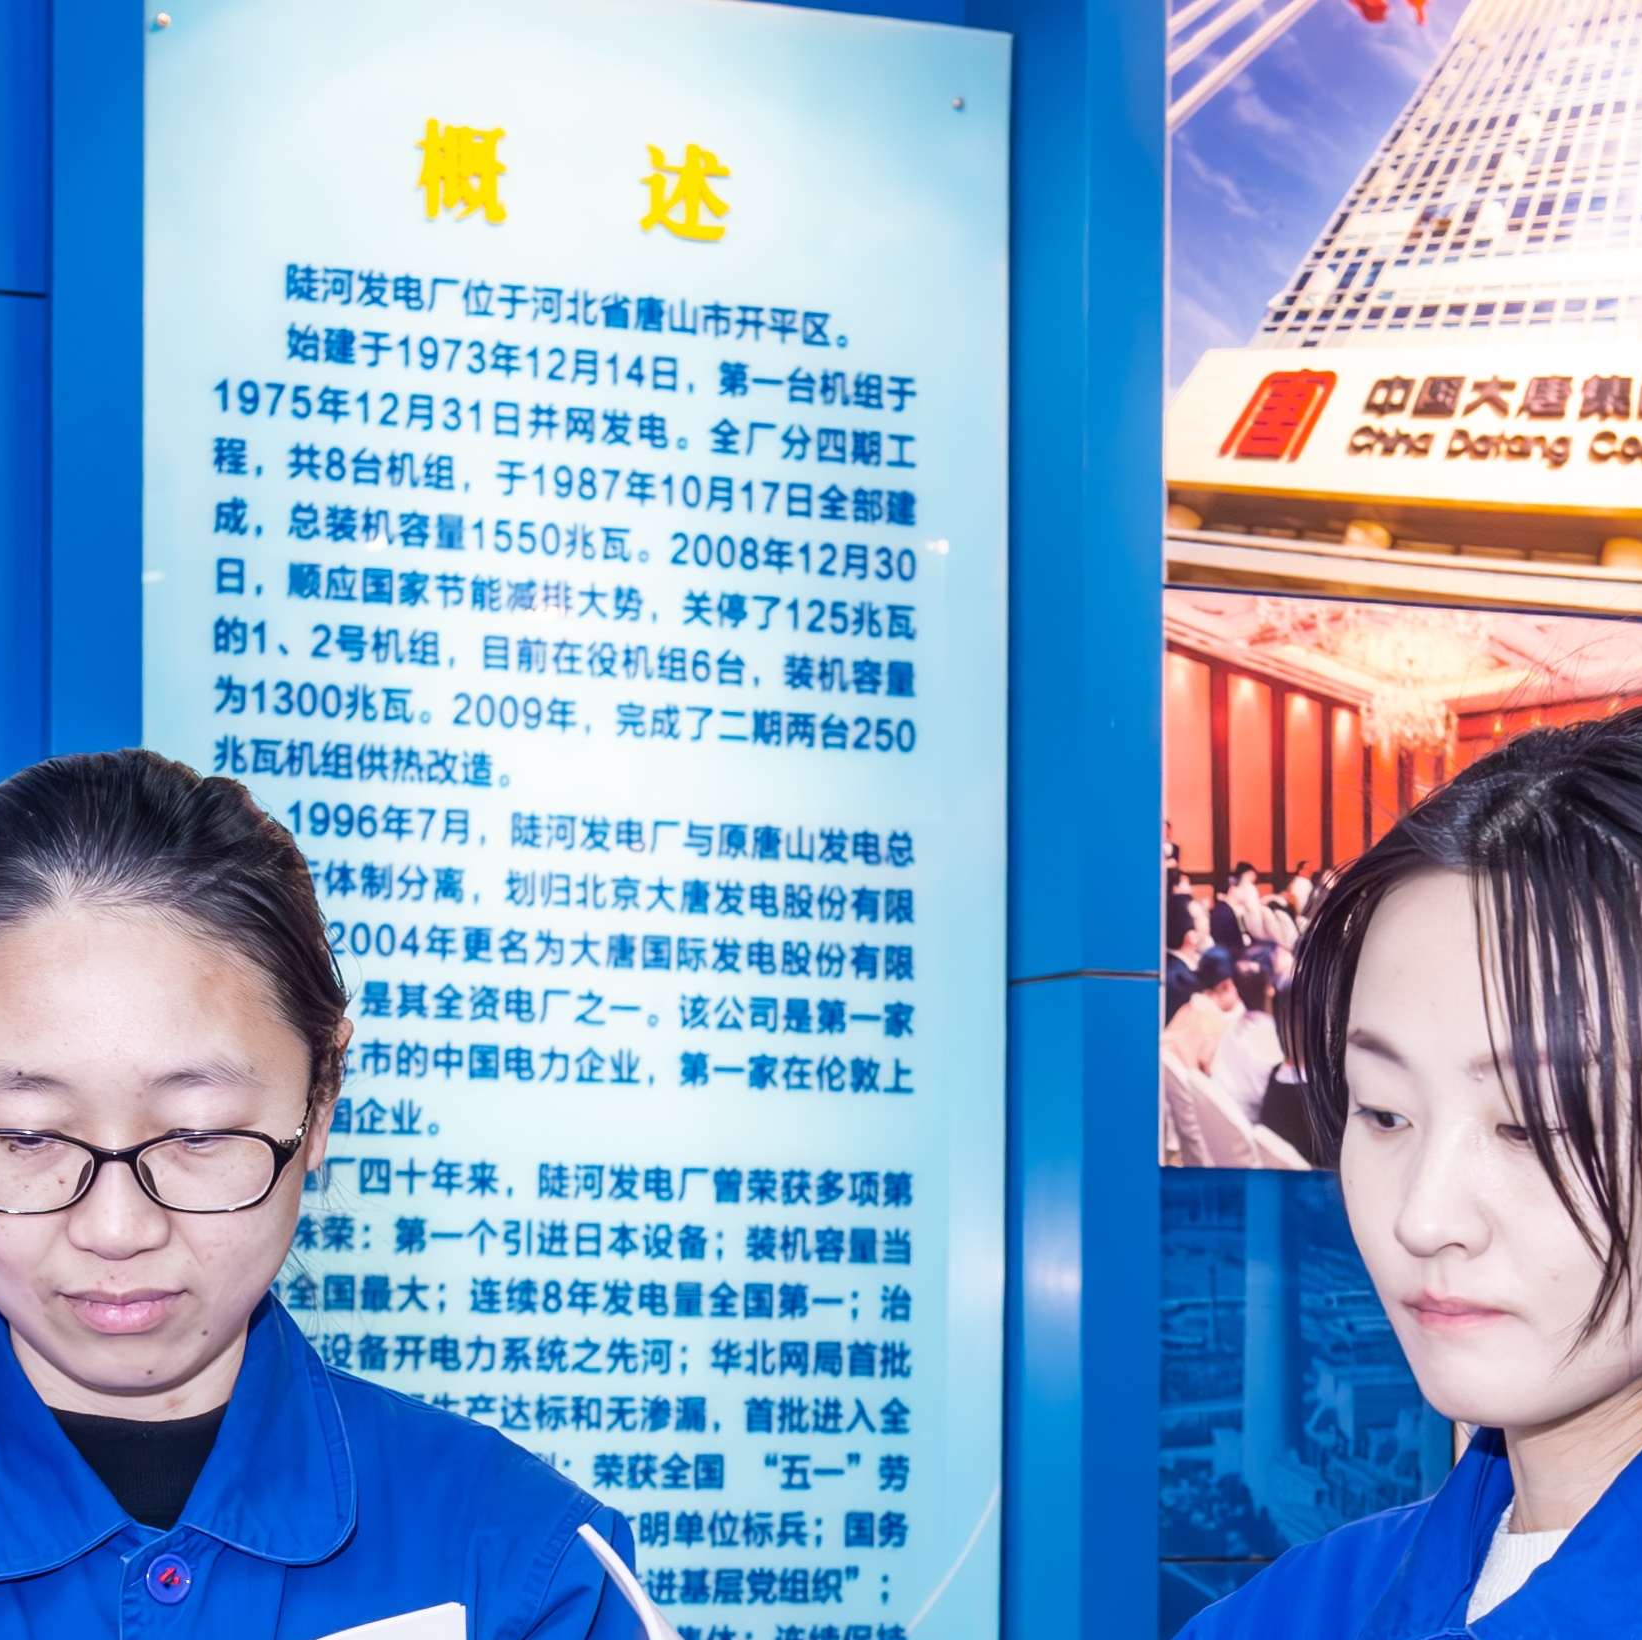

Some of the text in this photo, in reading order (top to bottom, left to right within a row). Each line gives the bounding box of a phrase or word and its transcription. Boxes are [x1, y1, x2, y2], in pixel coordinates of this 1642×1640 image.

[416, 118, 730, 241] 概述
[285, 264, 851, 349] 陡河发电厂位于河北省唐山市开平区。
[286, 326, 917, 413] 始建于1973年12月14日，第一台机组于
[212, 380, 917, 469] 1975年12月31日并网发电。全厂分四期工
[212, 438, 917, 526] 程，共8台机组，于1987年10月17日全部建
[213, 498, 917, 581] 成，总装机容量1550兆瓦。2008年12月30
[214, 558, 917, 640] 日，顺应国家节能减排大势，关停了125兆瓦
[212, 617, 917, 698] 的1、2号机组，目前在役机组6台，装机容量
[212, 676, 917, 753] 为1300兆瓦。2009年，完成了二期两台250
[212, 736, 511, 790] 兆瓦机组供热改造。
[288, 800, 916, 868] 1996年7月，陡河发电厂与原唐山发电总
[329, 921, 915, 983] 2004年更名为大唐国际发电股份有限
[360, 980, 915, 1040] 是其全资电厂之一。该公司是第一家
[267, 1274, 913, 1323] 全国最大；连续8年发电量全国第一；治
[307, 1333, 913, 1379] 设备开电力系统之先河；华北网局首批
[624, 1508, 910, 1548] 明单位标兵；国务
[636, 1565, 890, 1605] 进基层党组织”；
